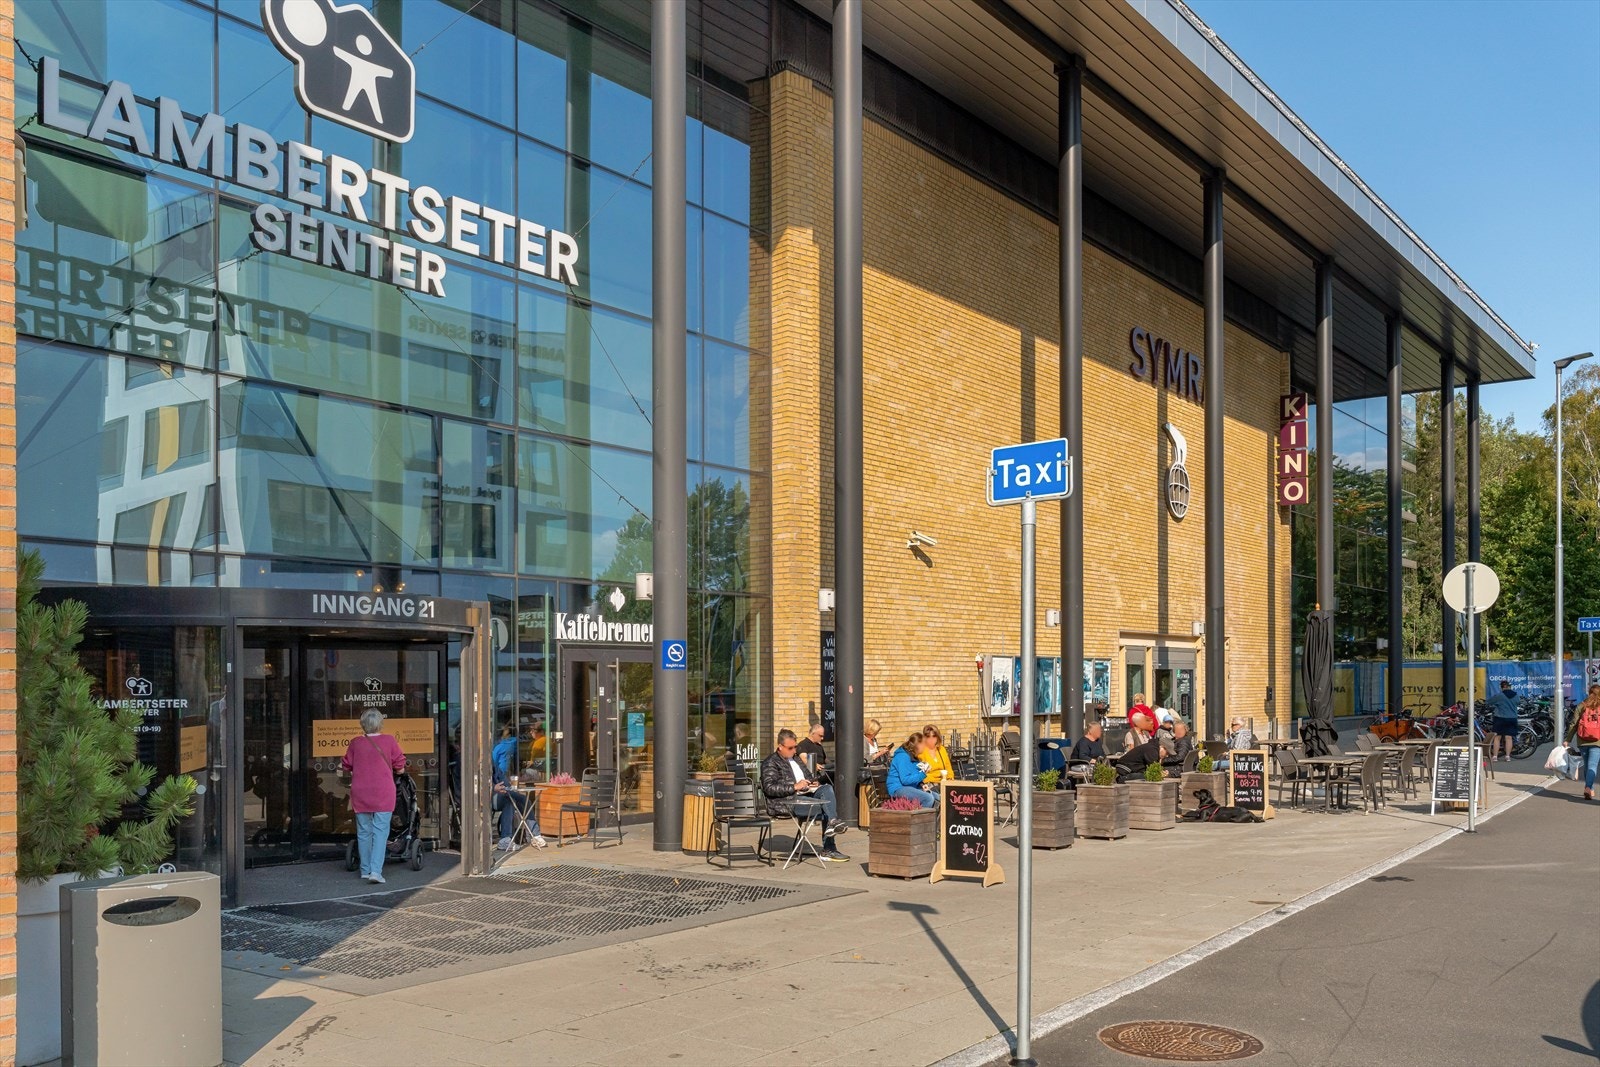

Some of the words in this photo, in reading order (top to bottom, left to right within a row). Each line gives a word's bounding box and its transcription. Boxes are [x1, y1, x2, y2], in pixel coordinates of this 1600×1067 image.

[38, 56, 580, 287] LAMBERTSETER
[251, 203, 447, 298] SENTER
[1129, 325, 1204, 405] SYMR
[1284, 397, 1304, 502] KINO
[997, 452, 1062, 488] Taxi
[313, 594, 415, 617] INNGANG
[418, 600, 434, 618] 21
[555, 612, 653, 642] Kaffebrenner
[1581, 620, 1600, 628] Taxi
[96, 699, 188, 709] LAMBERTSETER
[736, 744, 758, 760] Kaffe
[949, 824, 983, 837] CORTADO
